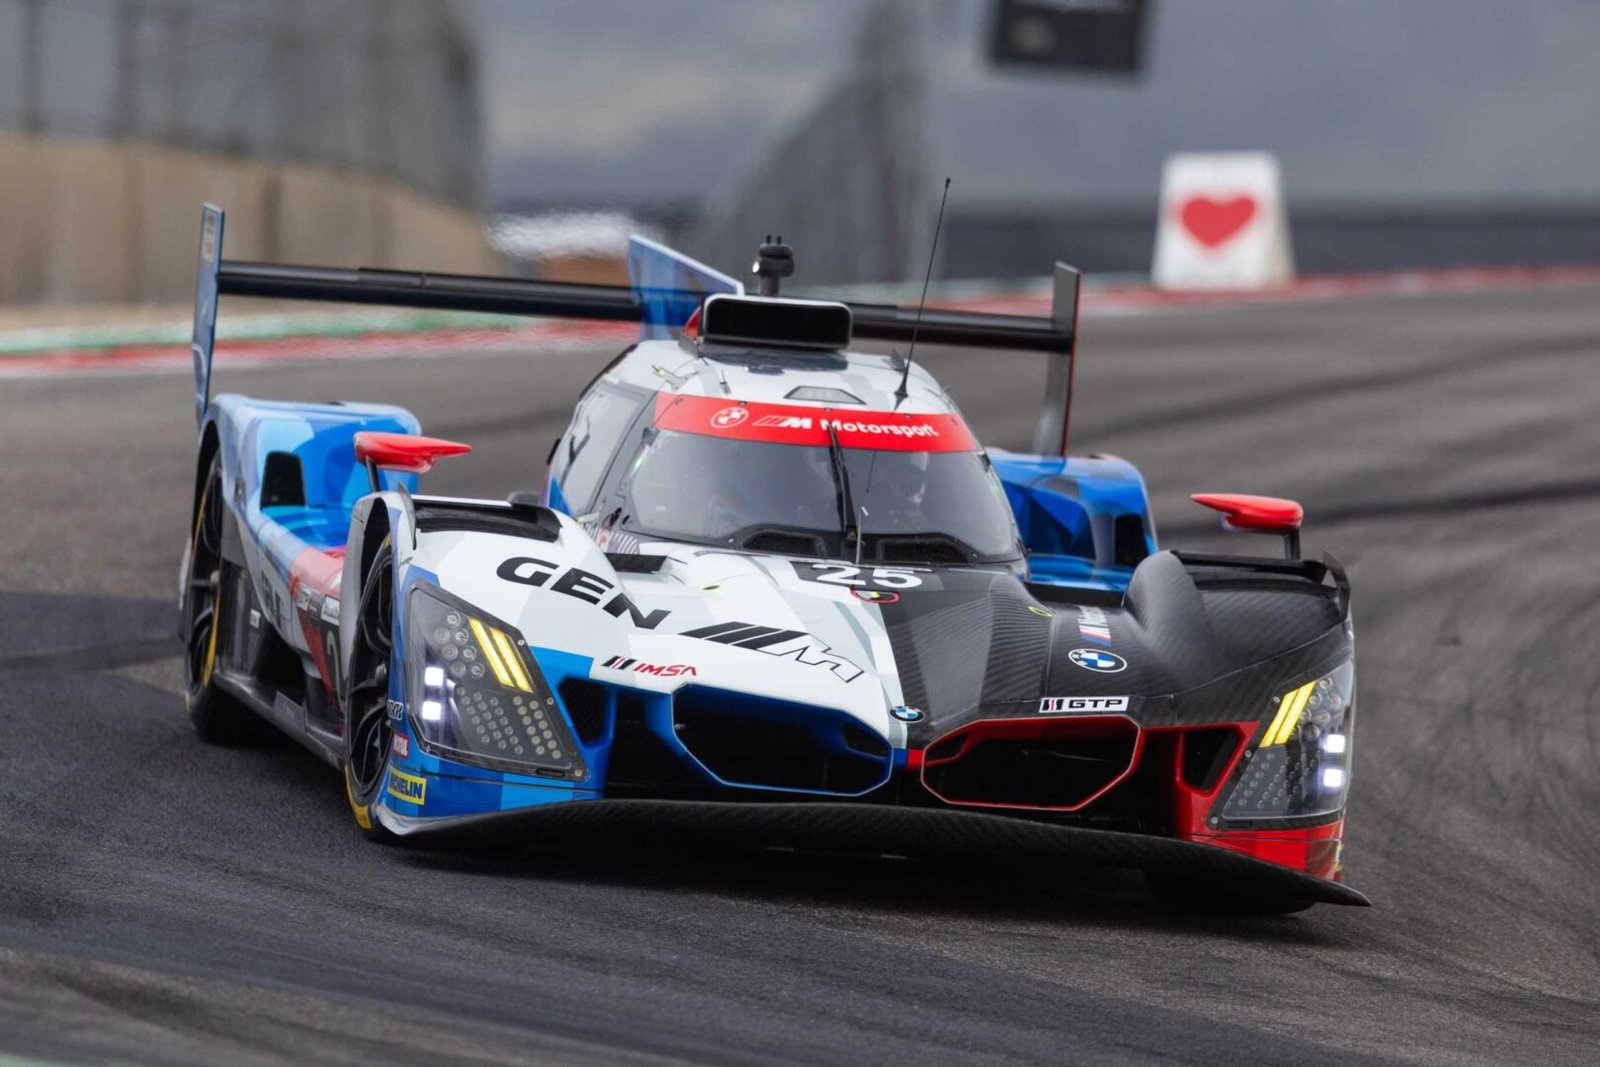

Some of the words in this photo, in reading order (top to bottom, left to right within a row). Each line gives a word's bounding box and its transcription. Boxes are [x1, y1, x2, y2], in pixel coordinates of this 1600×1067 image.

[819, 418, 939, 438] Motorsport
[811, 562, 924, 589] 25
[496, 556, 672, 630] GEN
[633, 663, 697, 677] IMSA
[1068, 699, 1123, 709] GTP
[388, 770, 424, 800] HELIN
